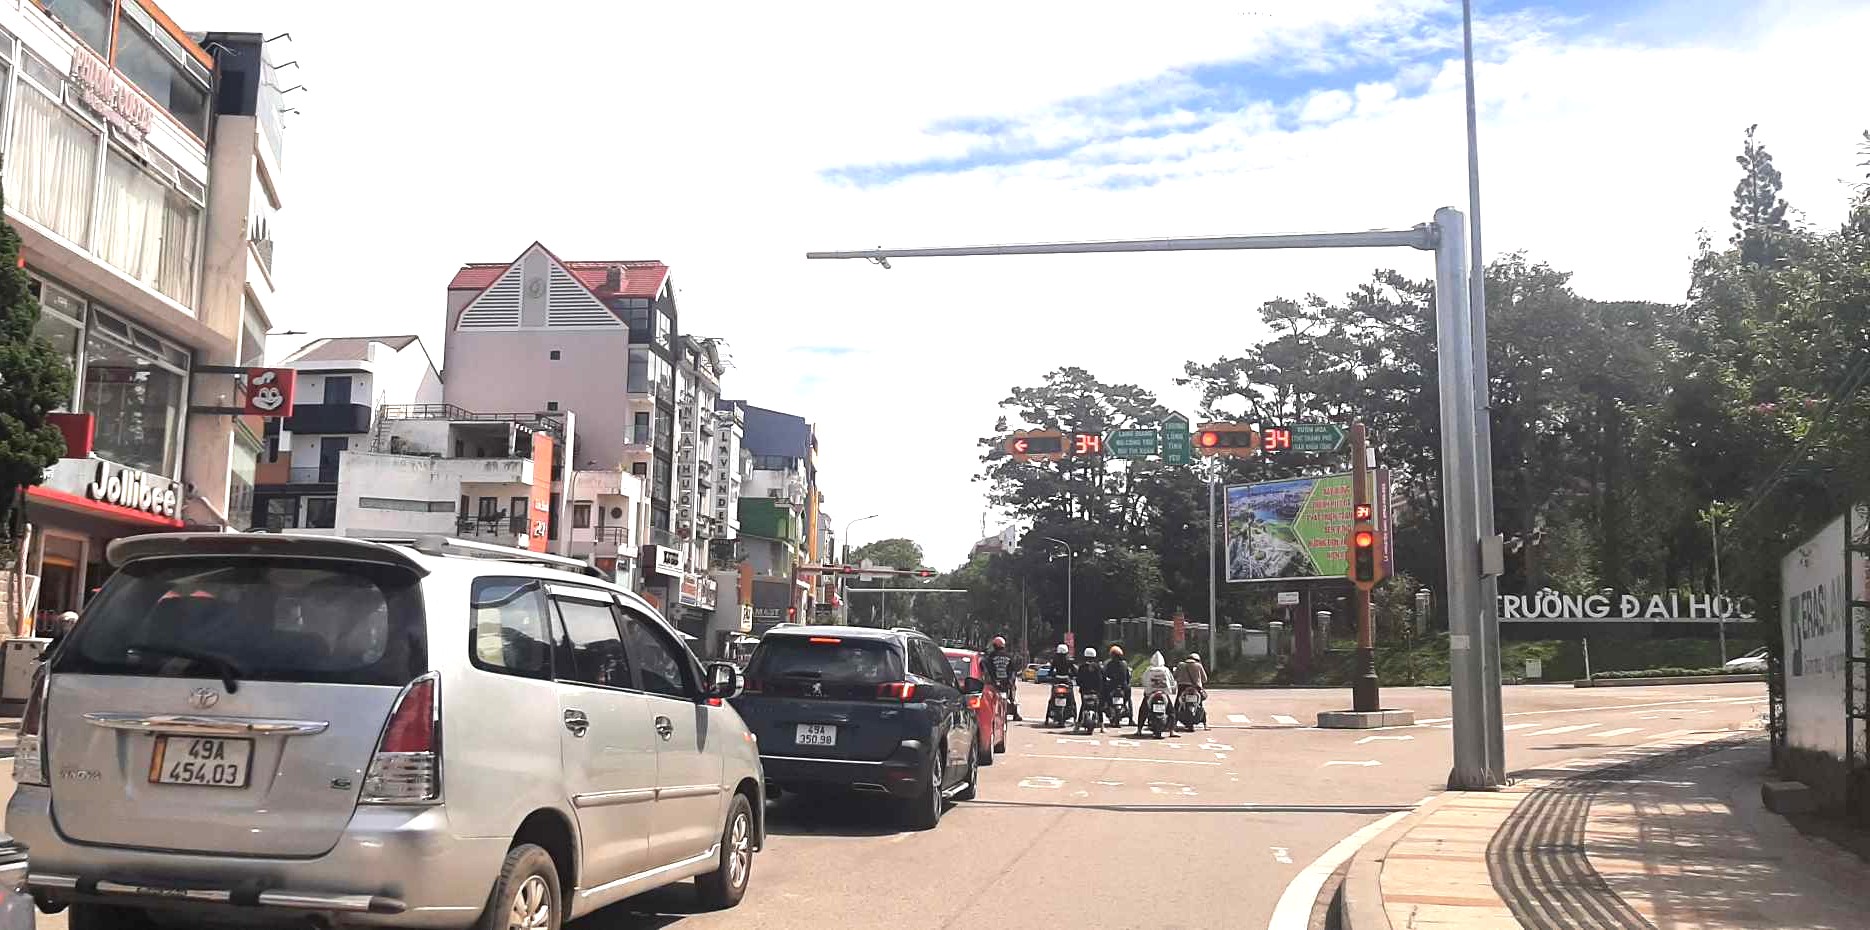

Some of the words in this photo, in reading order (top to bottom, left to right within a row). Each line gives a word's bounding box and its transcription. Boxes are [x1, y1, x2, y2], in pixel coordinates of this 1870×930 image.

[1076, 434, 1099, 454] 34
[1264, 428, 1289, 449] 34
[92, 460, 176, 516] Jollibee
[1357, 506, 1369, 517] 34
[188, 739, 225, 760] 49A
[169, 761, 238, 785] 454.03
